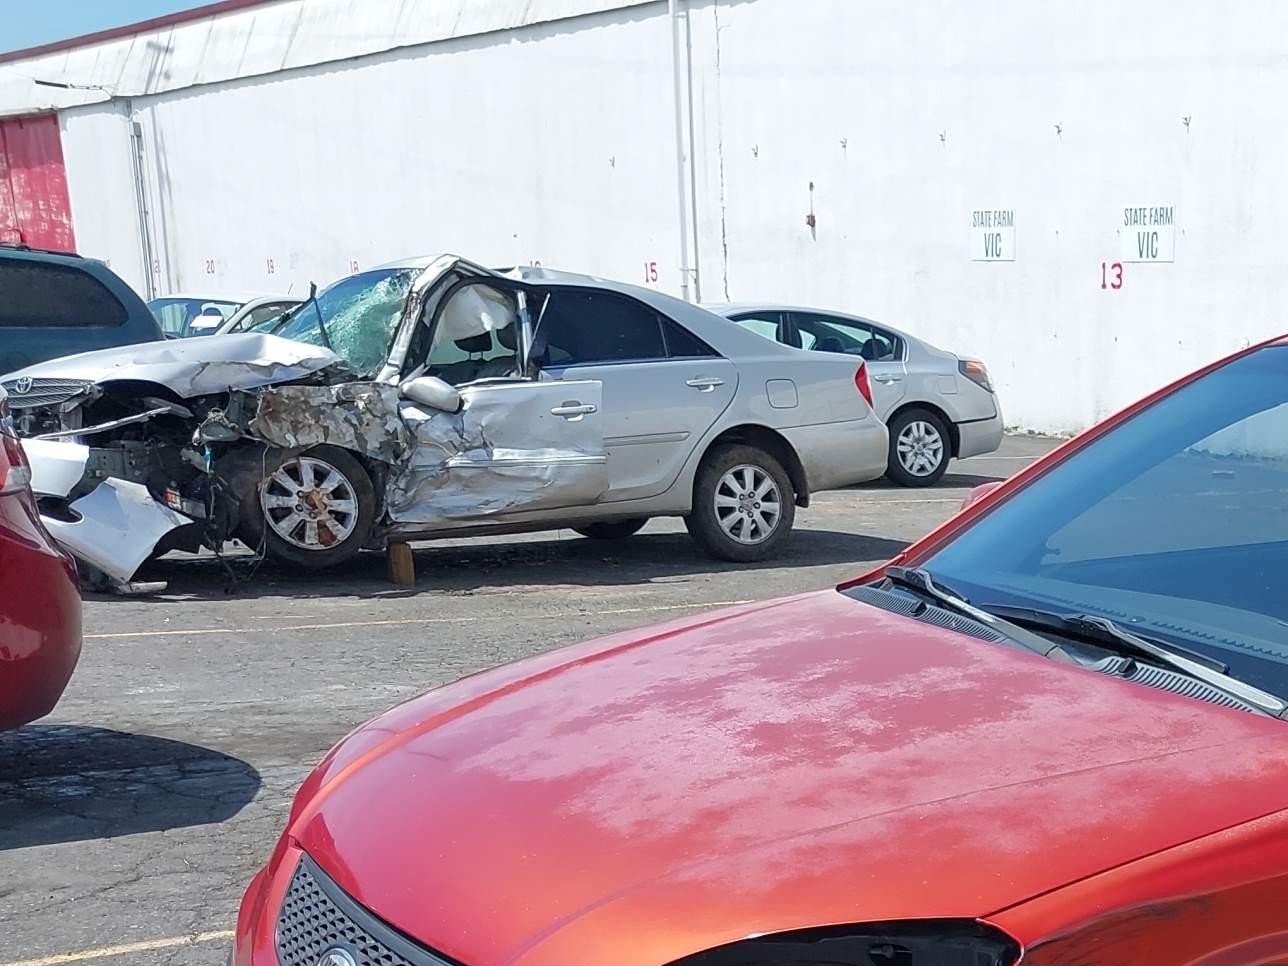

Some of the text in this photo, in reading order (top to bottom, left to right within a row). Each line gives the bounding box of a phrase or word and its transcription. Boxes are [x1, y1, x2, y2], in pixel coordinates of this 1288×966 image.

[972, 209, 1014, 228] STATE FARM
[1124, 206, 1174, 226] STATE FARM
[983, 232, 1002, 258] VIC
[1137, 231, 1159, 259] VIC
[206, 259, 215, 274] 20
[266, 258, 275, 275] 19
[644, 261, 658, 283] 15
[1101, 262, 1123, 290] 13
